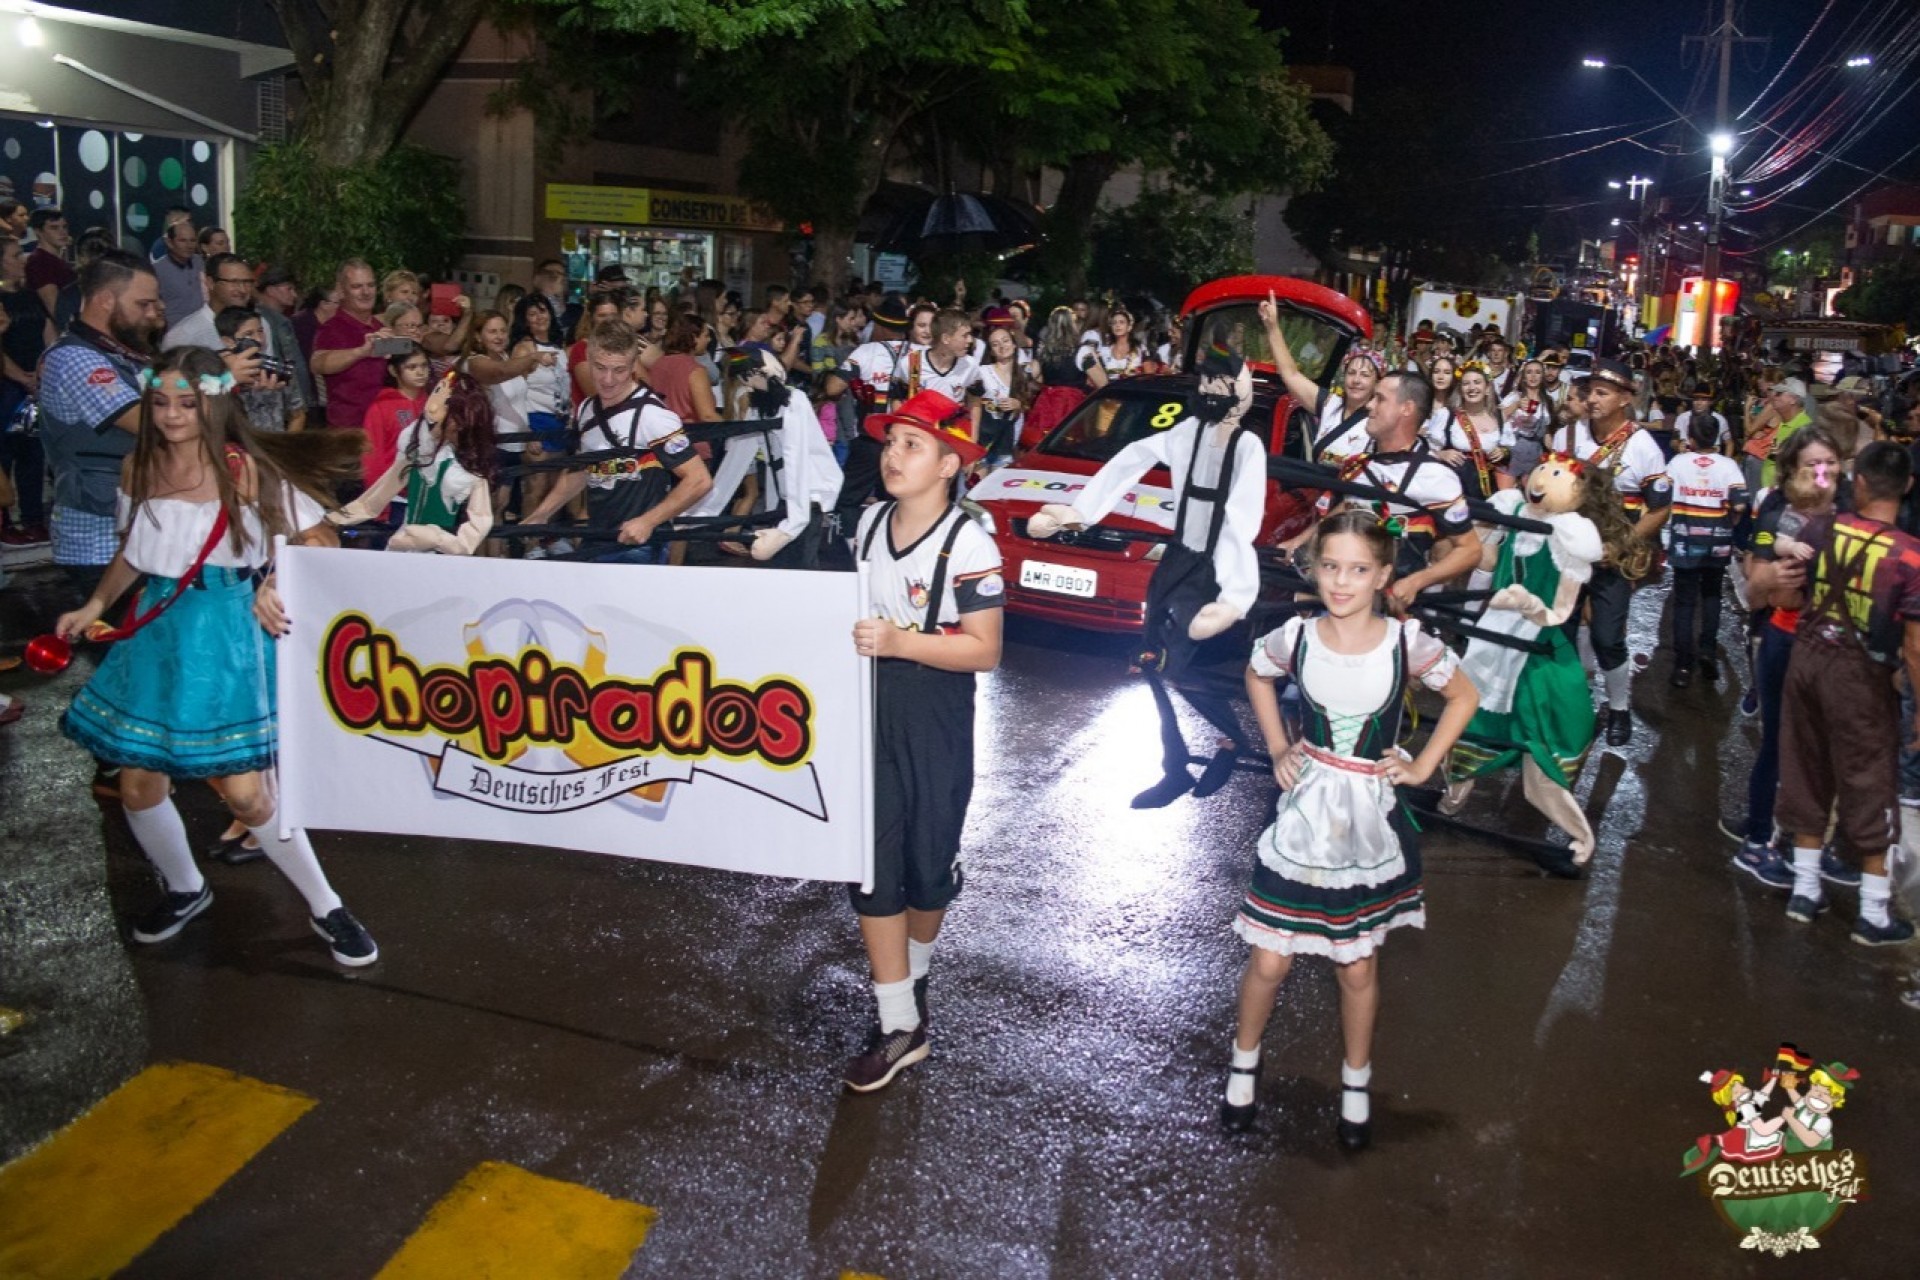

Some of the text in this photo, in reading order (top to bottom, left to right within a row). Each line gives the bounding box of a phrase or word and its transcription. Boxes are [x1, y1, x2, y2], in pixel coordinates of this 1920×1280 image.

[651, 198, 727, 221] CONSERTO
[1151, 402, 1184, 428] 8
[1023, 570, 1093, 592] AMR 0807
[323, 611, 814, 769] Chopirados
[470, 759, 652, 808] Deutsches Fest
